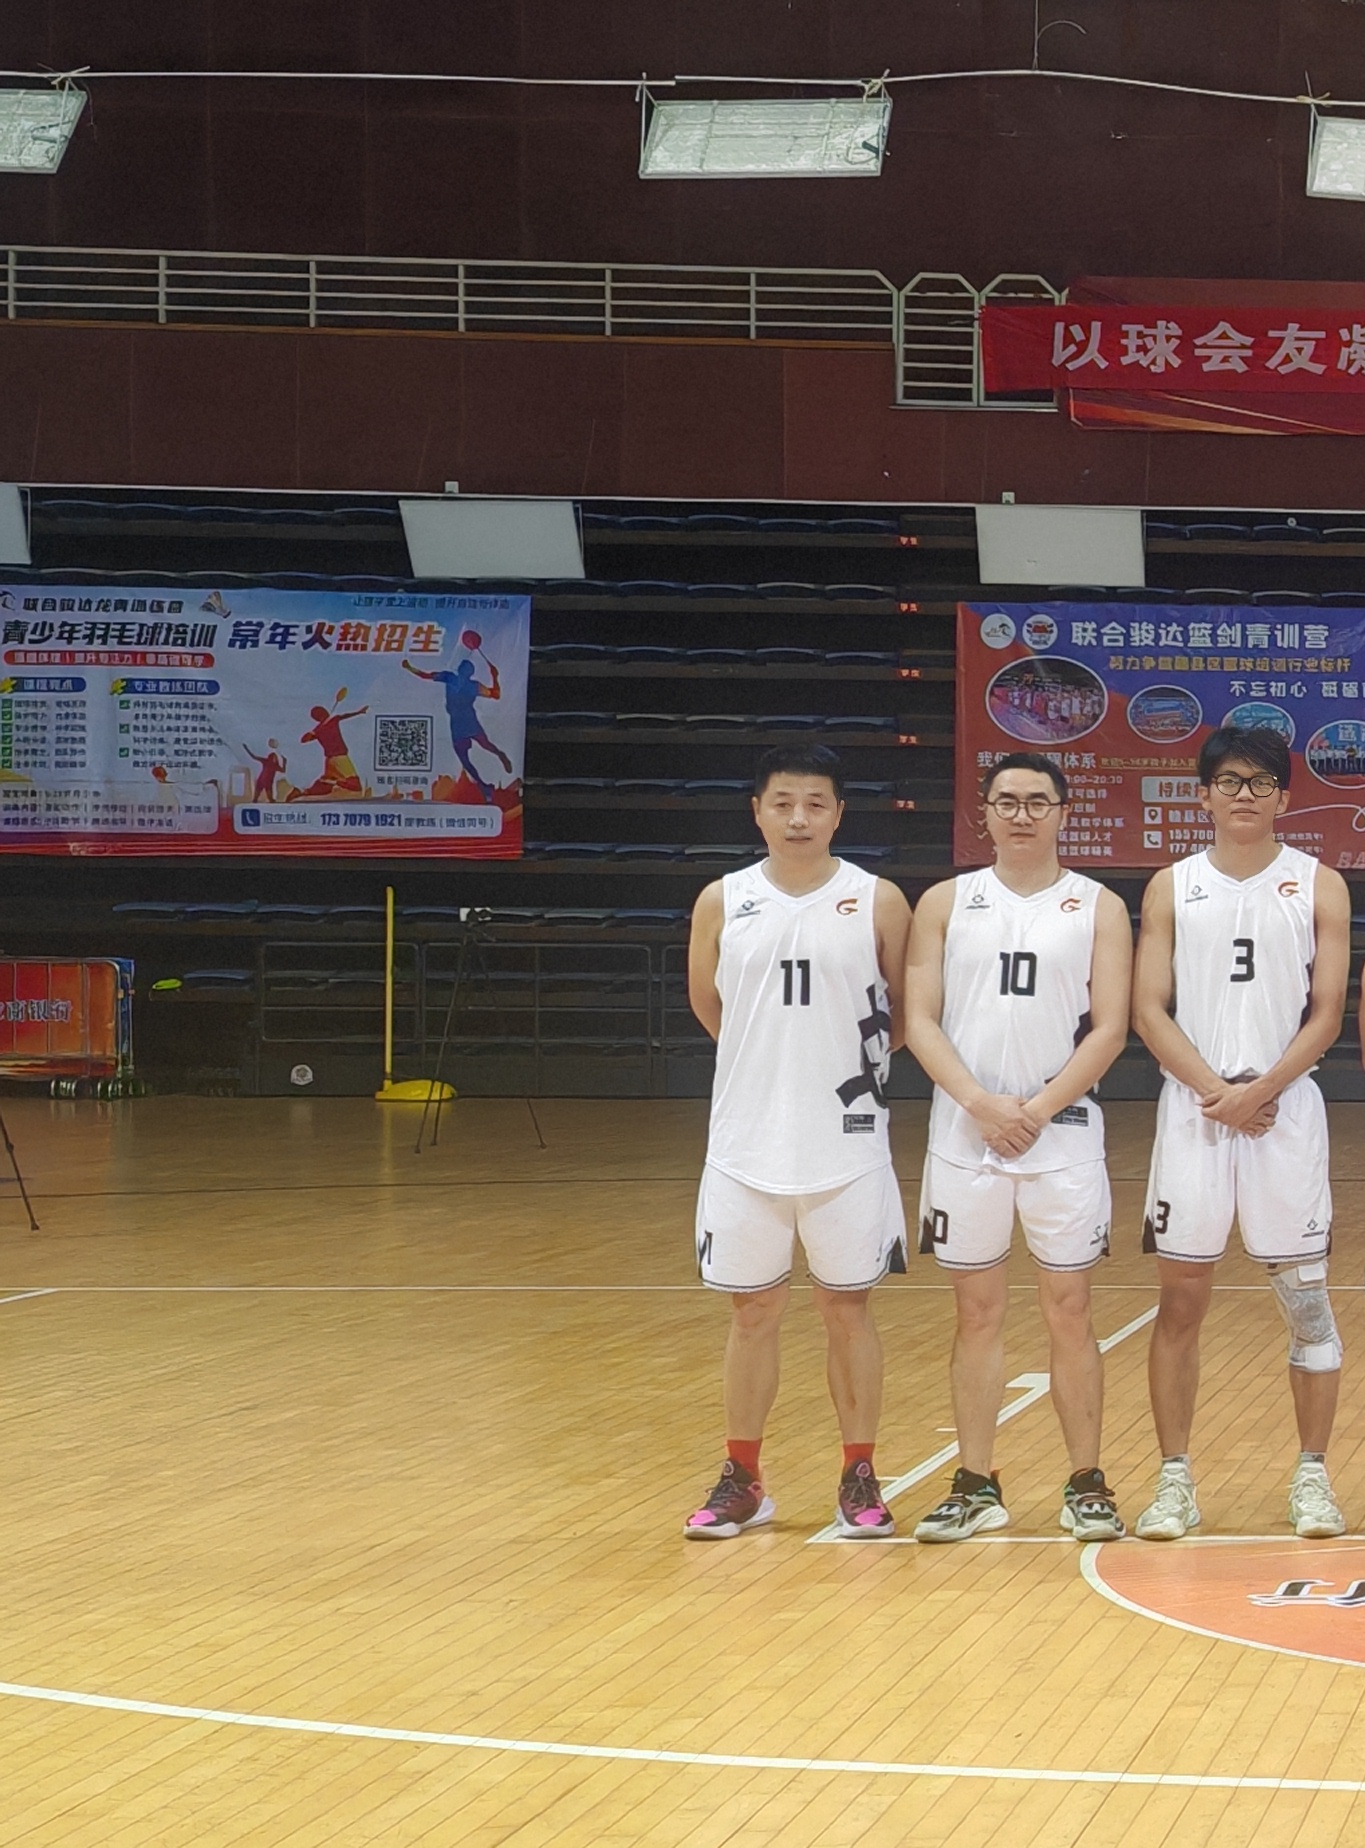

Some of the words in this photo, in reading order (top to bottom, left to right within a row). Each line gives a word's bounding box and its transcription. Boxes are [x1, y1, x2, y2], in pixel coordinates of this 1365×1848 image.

[2, 620, 218, 649] 青少年羽毛球培训
[227, 620, 443, 653] 常年火热招生
[1229, 680, 1308, 698] 不忘初心
[320, 813, 340, 826] 173
[1000, 952, 1038, 997] 10
[1230, 938, 1255, 982] 3
[780, 959, 811, 1006] 11
[1155, 1201, 1171, 1234] 3
